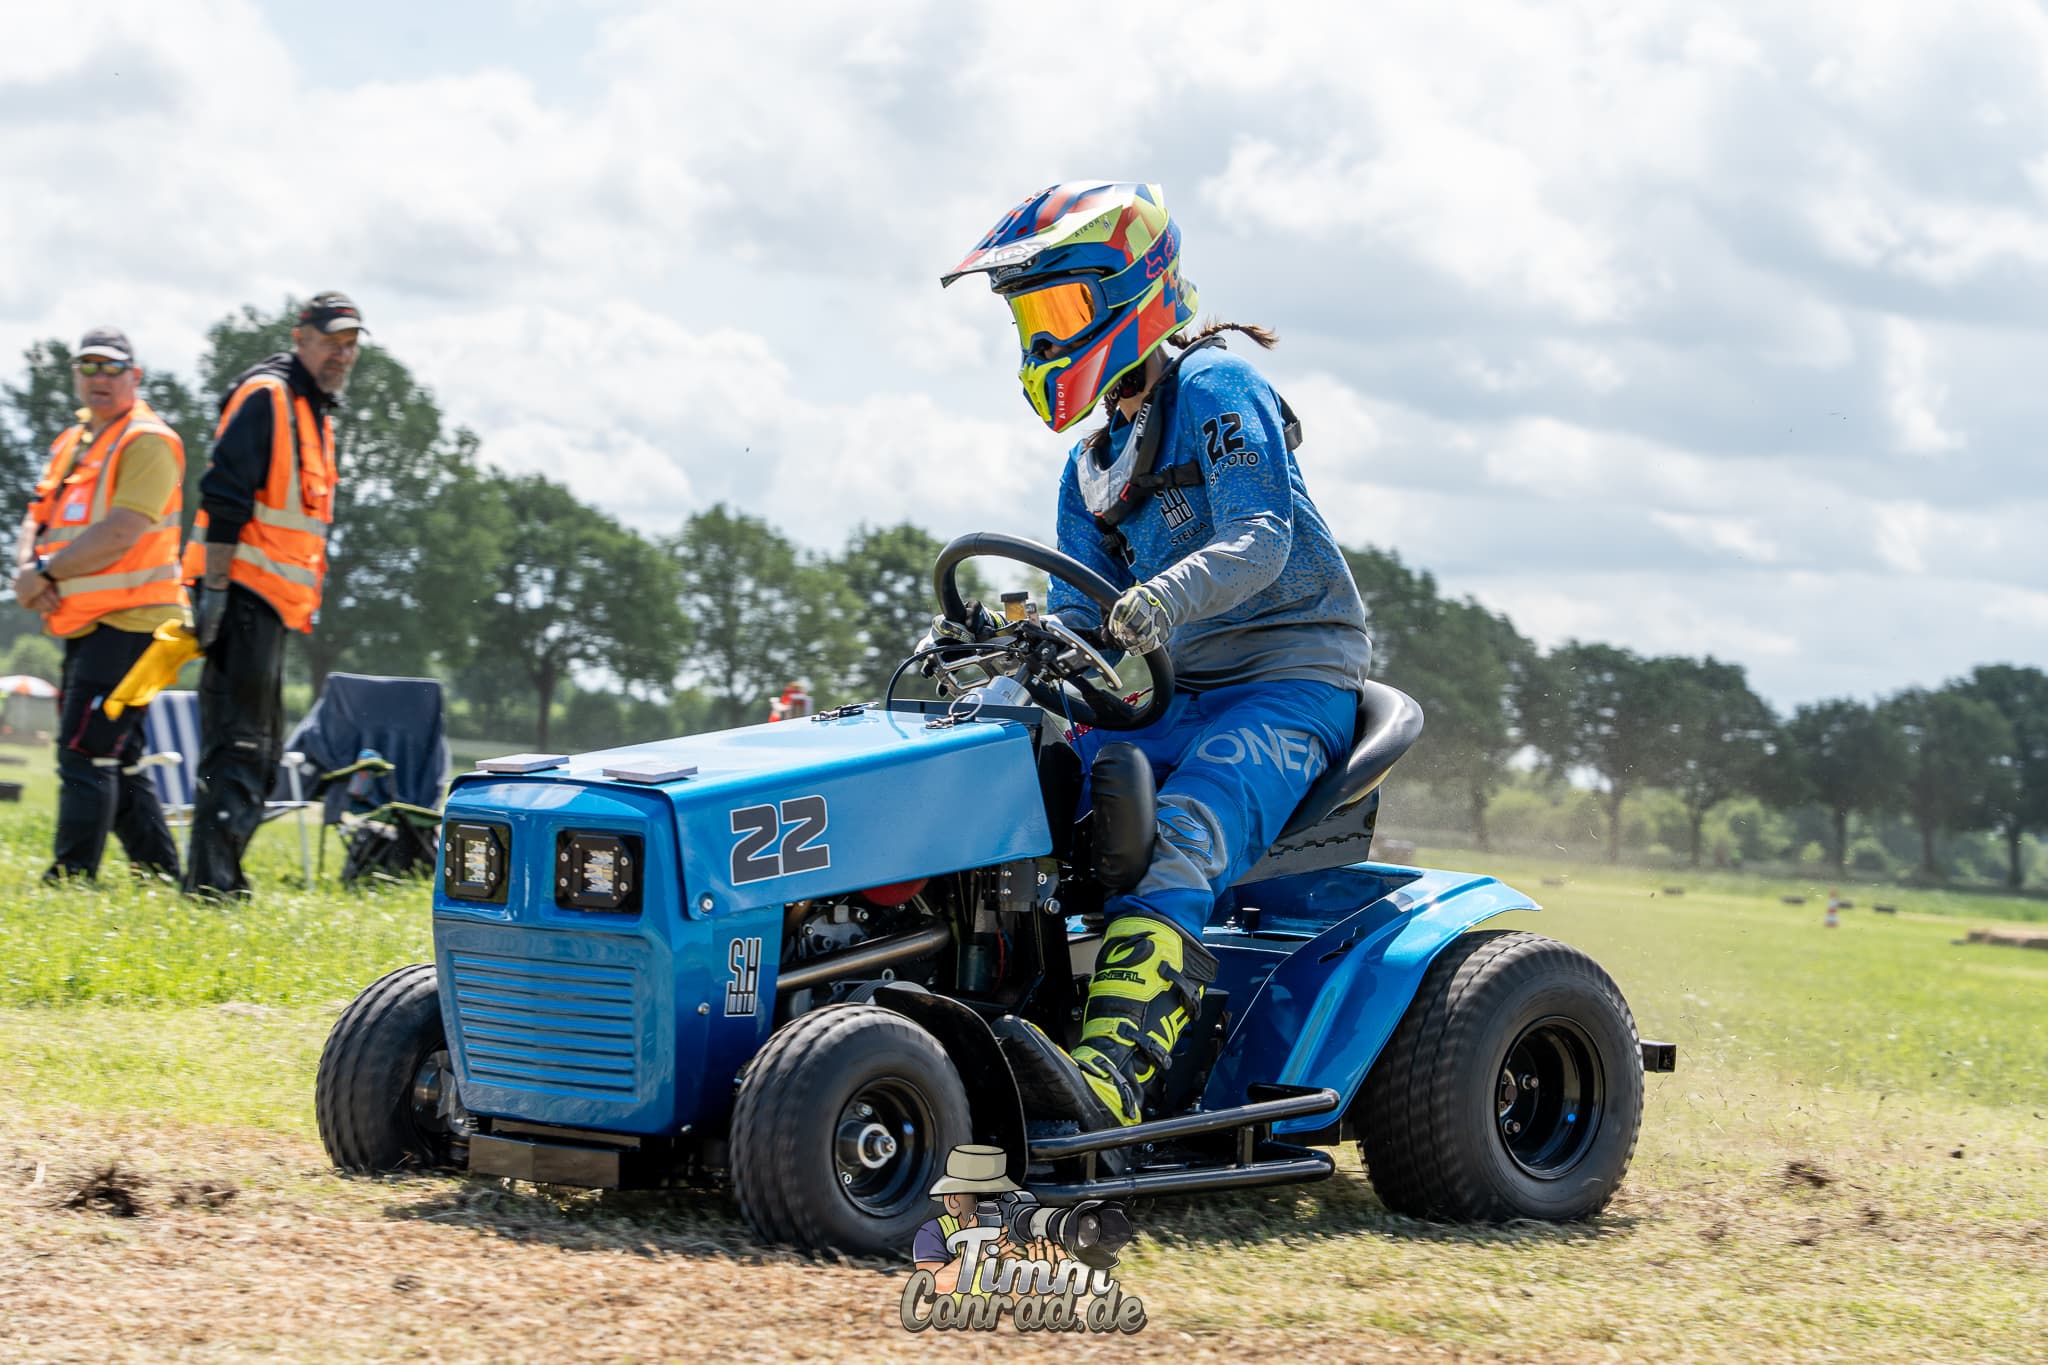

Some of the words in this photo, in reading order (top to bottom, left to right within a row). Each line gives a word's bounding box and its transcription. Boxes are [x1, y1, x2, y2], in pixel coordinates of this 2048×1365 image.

[1057, 383, 1066, 420] AIROH
[1201, 412, 1245, 468] 22
[1170, 522, 1209, 547] STELLA
[730, 795, 830, 885] 22
